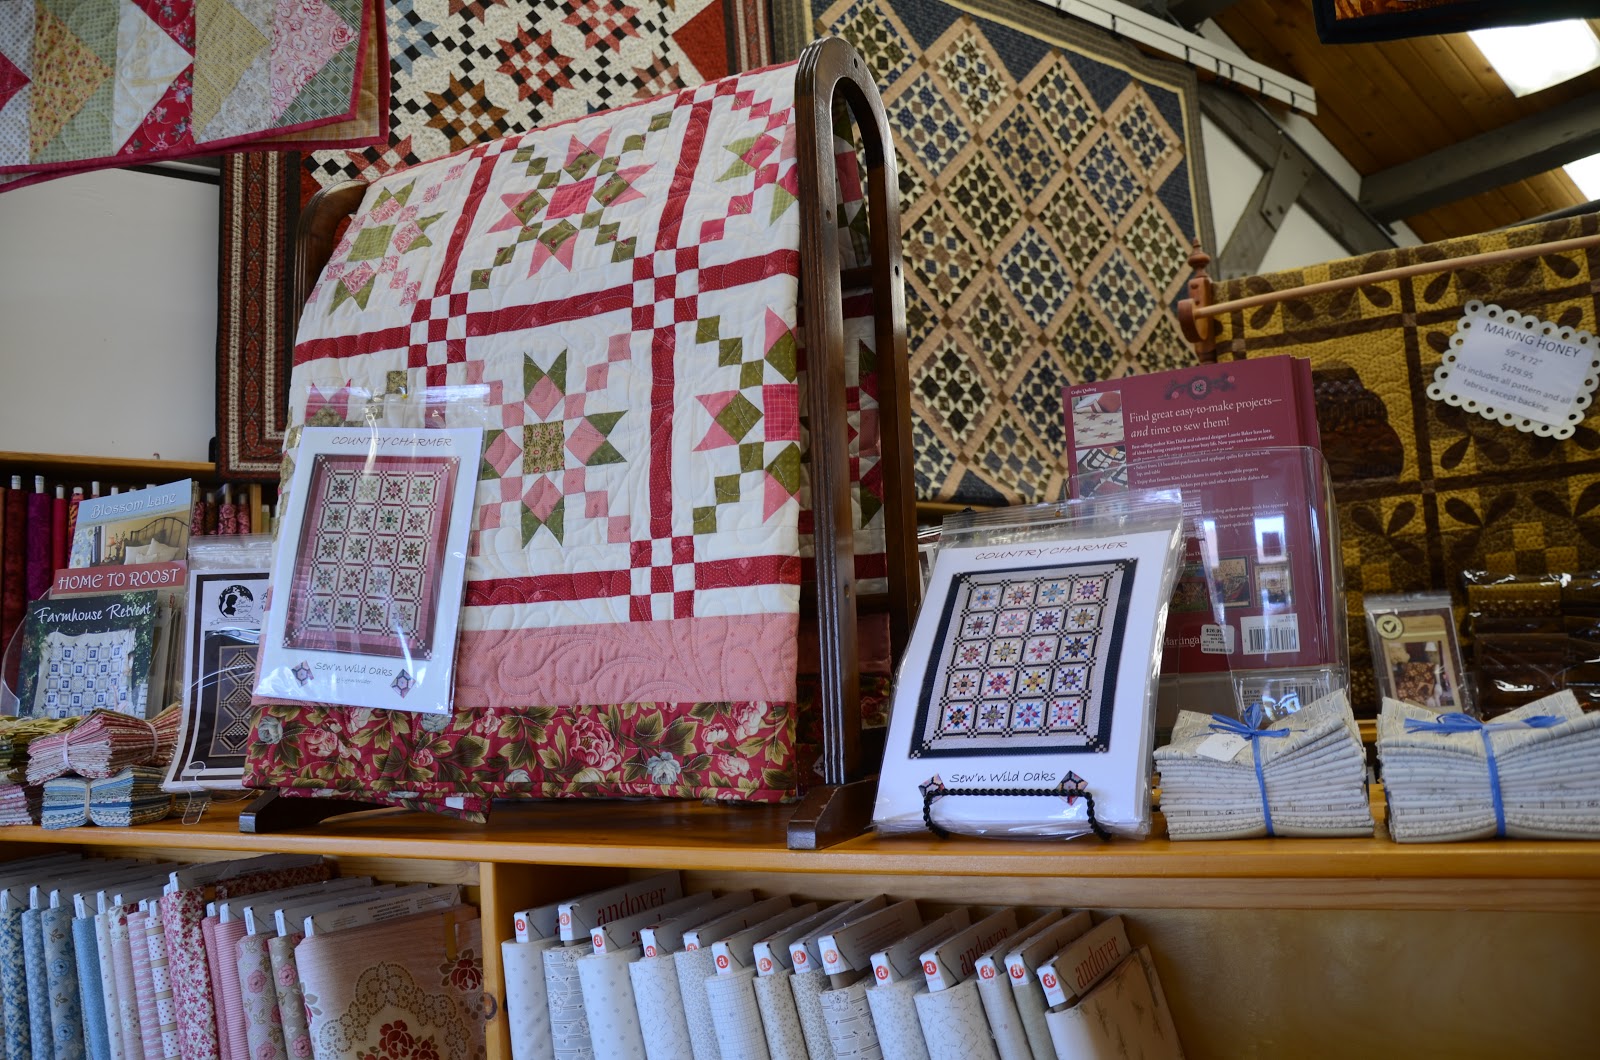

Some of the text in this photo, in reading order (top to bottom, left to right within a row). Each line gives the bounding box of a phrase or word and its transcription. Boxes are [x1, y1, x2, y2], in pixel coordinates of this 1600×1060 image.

[1484, 323, 1581, 358] MAKING HONEY
[1456, 363, 1467, 372] Kit
[1467, 365, 1500, 383] includes
[1500, 376, 1511, 386] all
[1511, 380, 1542, 397] pattern
[1543, 389, 1559, 401] and
[1501, 363, 1534, 380] $129.95
[1463, 378, 1489, 393] fabrics
[1490, 388, 1516, 404] except
[1129, 410, 1150, 423] Find
[1151, 409, 1174, 424] great
[1175, 400, 1234, 419] easy-to-make
[1130, 416, 1230, 438] and time to sew them!
[332, 436, 452, 450] COUNTRY CHARMER
[90, 500, 144, 519] Blossom
[147, 493, 176, 508] Lane
[975, 541, 1128, 560] COUNTRY CHARMER
[58, 568, 180, 590] HOME TO ROOST
[34, 603, 152, 624] Farmhouse Retreat
[314, 662, 393, 677] Sew'n Wild Oaks
[949, 770, 1056, 783] Sew'n Wild Oaks
[597, 887, 666, 926] andover
[1074, 936, 1122, 990] andover
